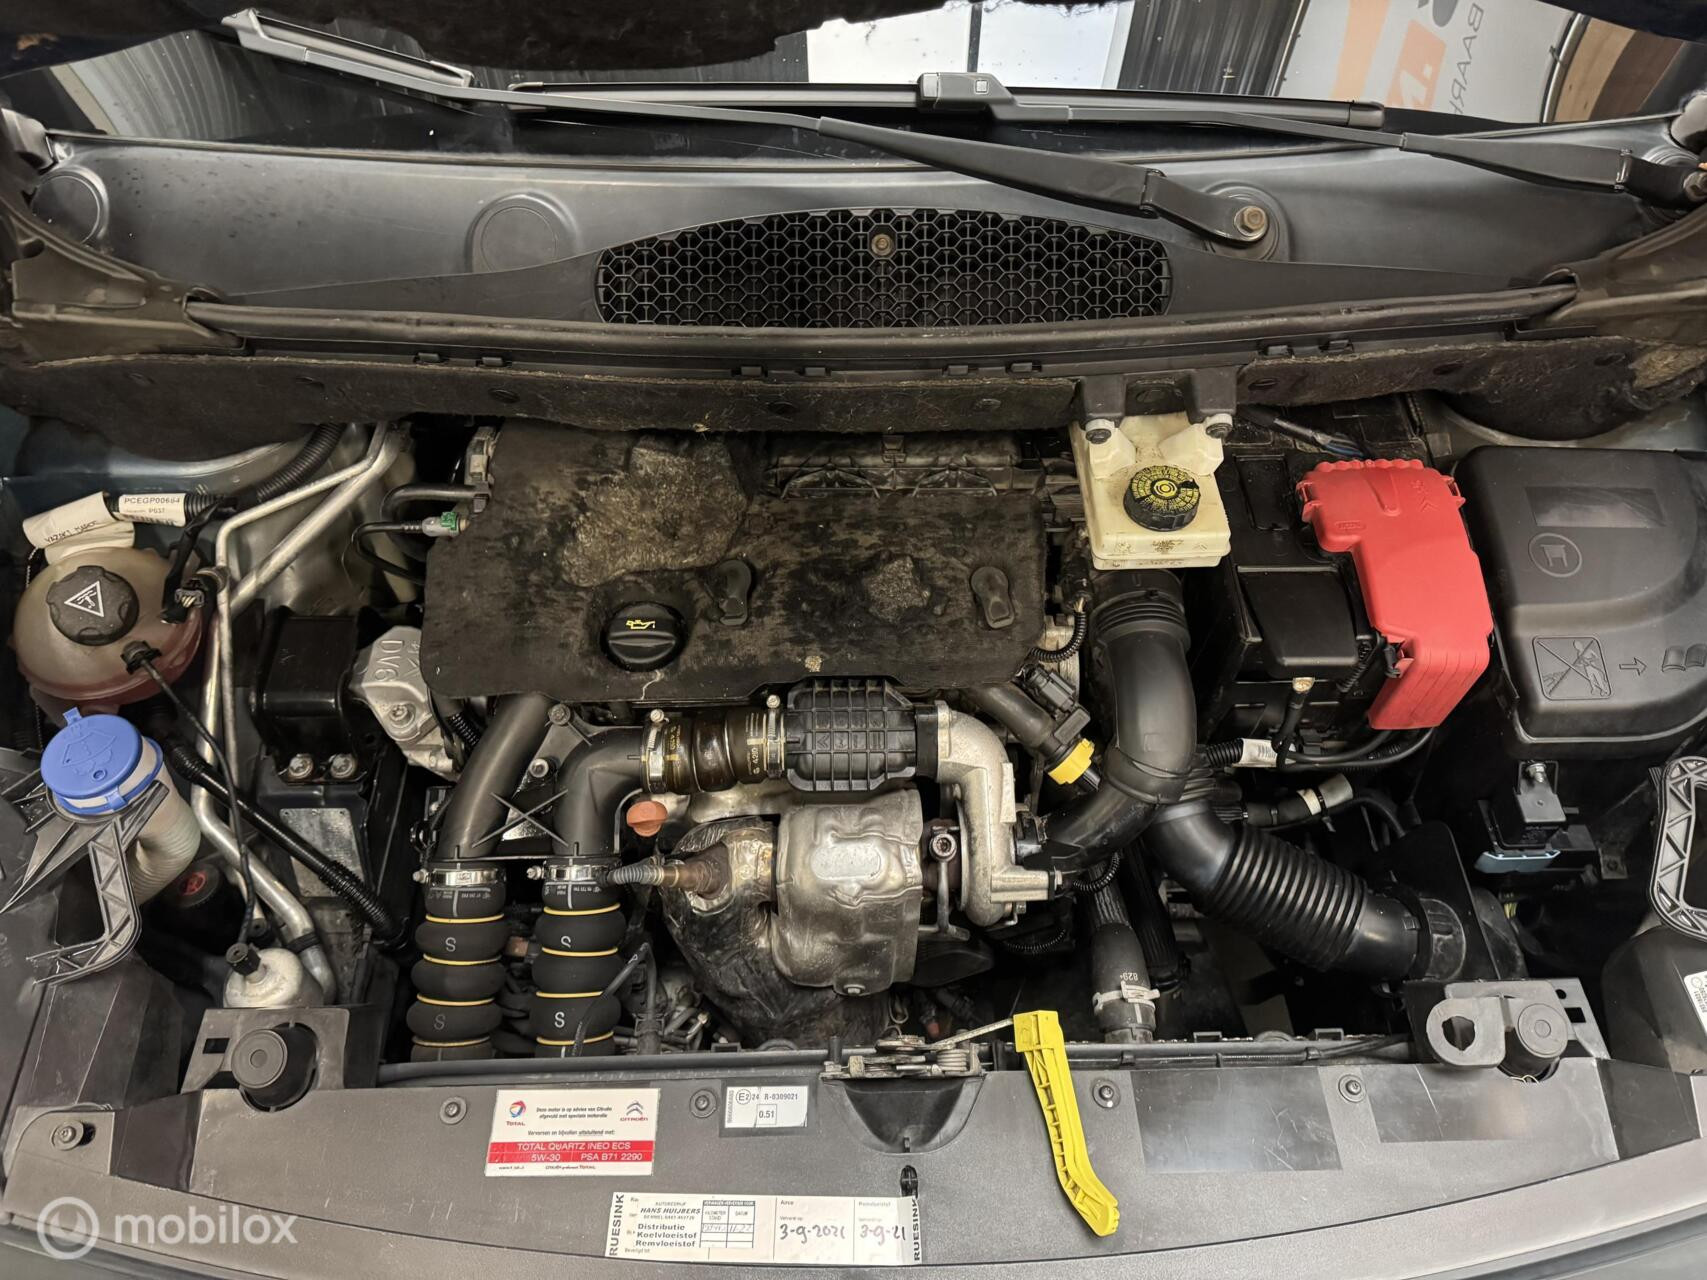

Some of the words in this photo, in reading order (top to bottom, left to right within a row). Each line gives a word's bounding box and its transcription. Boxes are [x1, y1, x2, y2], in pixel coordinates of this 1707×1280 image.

[373, 640, 405, 682] DV6
[554, 1011, 565, 1028] S
[759, 1110, 775, 1118] 0.51
[517, 1143, 546, 1151] TOTAL
[548, 1143, 586, 1151] QUARTZ
[587, 1142, 610, 1150] INEO
[612, 1142, 631, 1150] ECS
[531, 1154, 561, 1162] 5W-30
[609, 1194, 625, 1256] RUESINK
[637, 1223, 686, 1231] Distributie
[911, 1198, 921, 1261] RUESINK
[636, 1231, 697, 1239] Koelvloeistof
